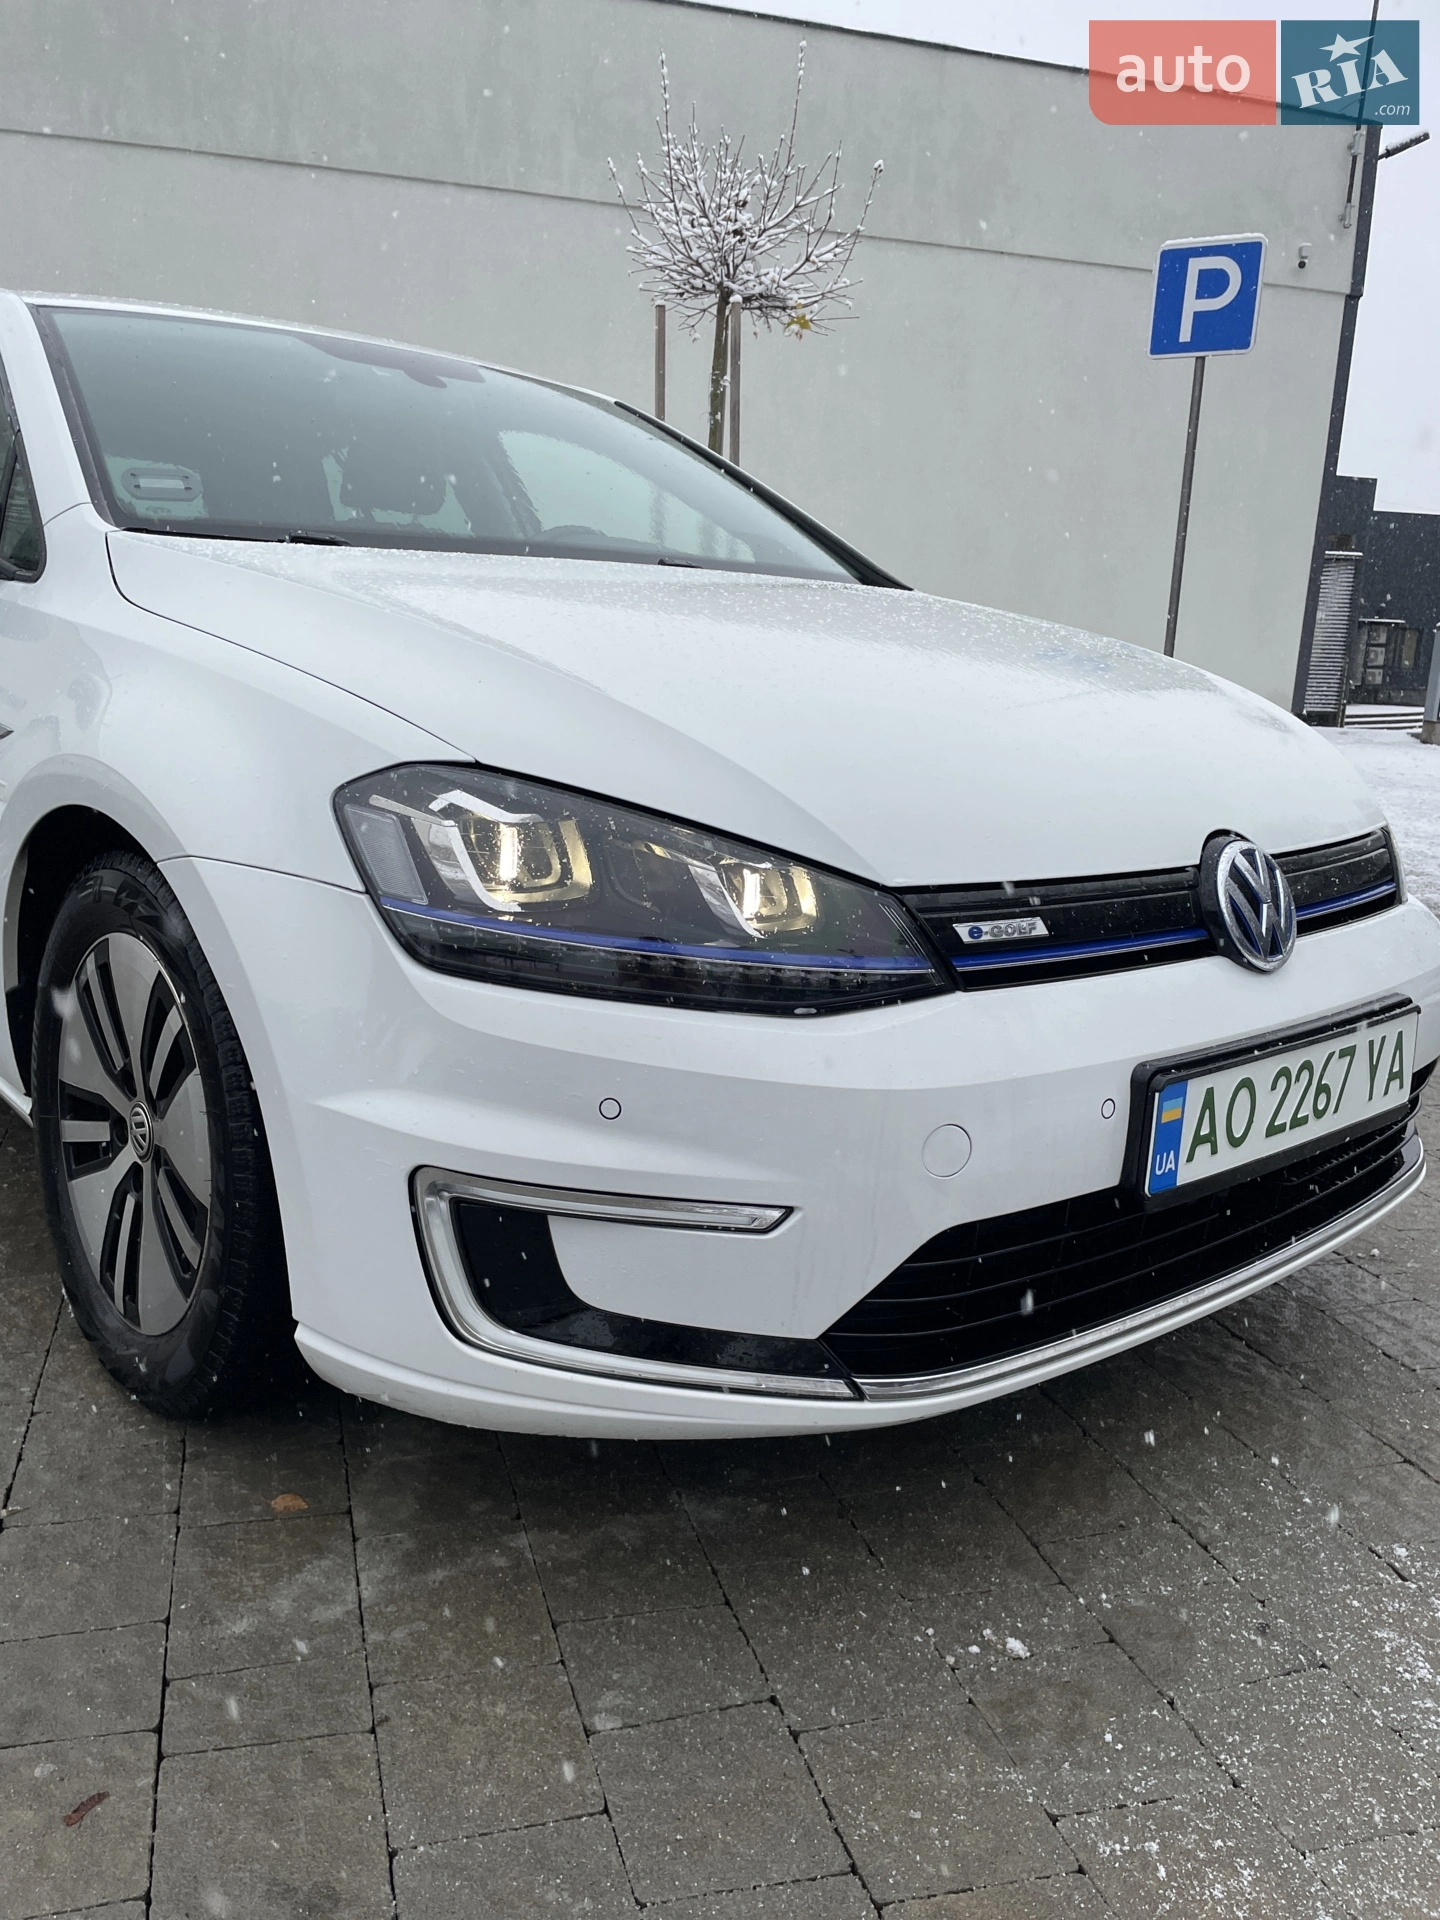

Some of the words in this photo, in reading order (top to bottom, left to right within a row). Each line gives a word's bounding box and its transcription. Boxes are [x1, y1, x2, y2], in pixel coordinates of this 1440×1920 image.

[1178, 255, 1242, 343] P
[967, 921, 1037, 940] e-GOLF
[1186, 1076, 1257, 1163] AO
[1265, 1045, 1357, 1138] 2267
[1367, 1029, 1404, 1102] YA
[1155, 1150, 1175, 1176] UA
